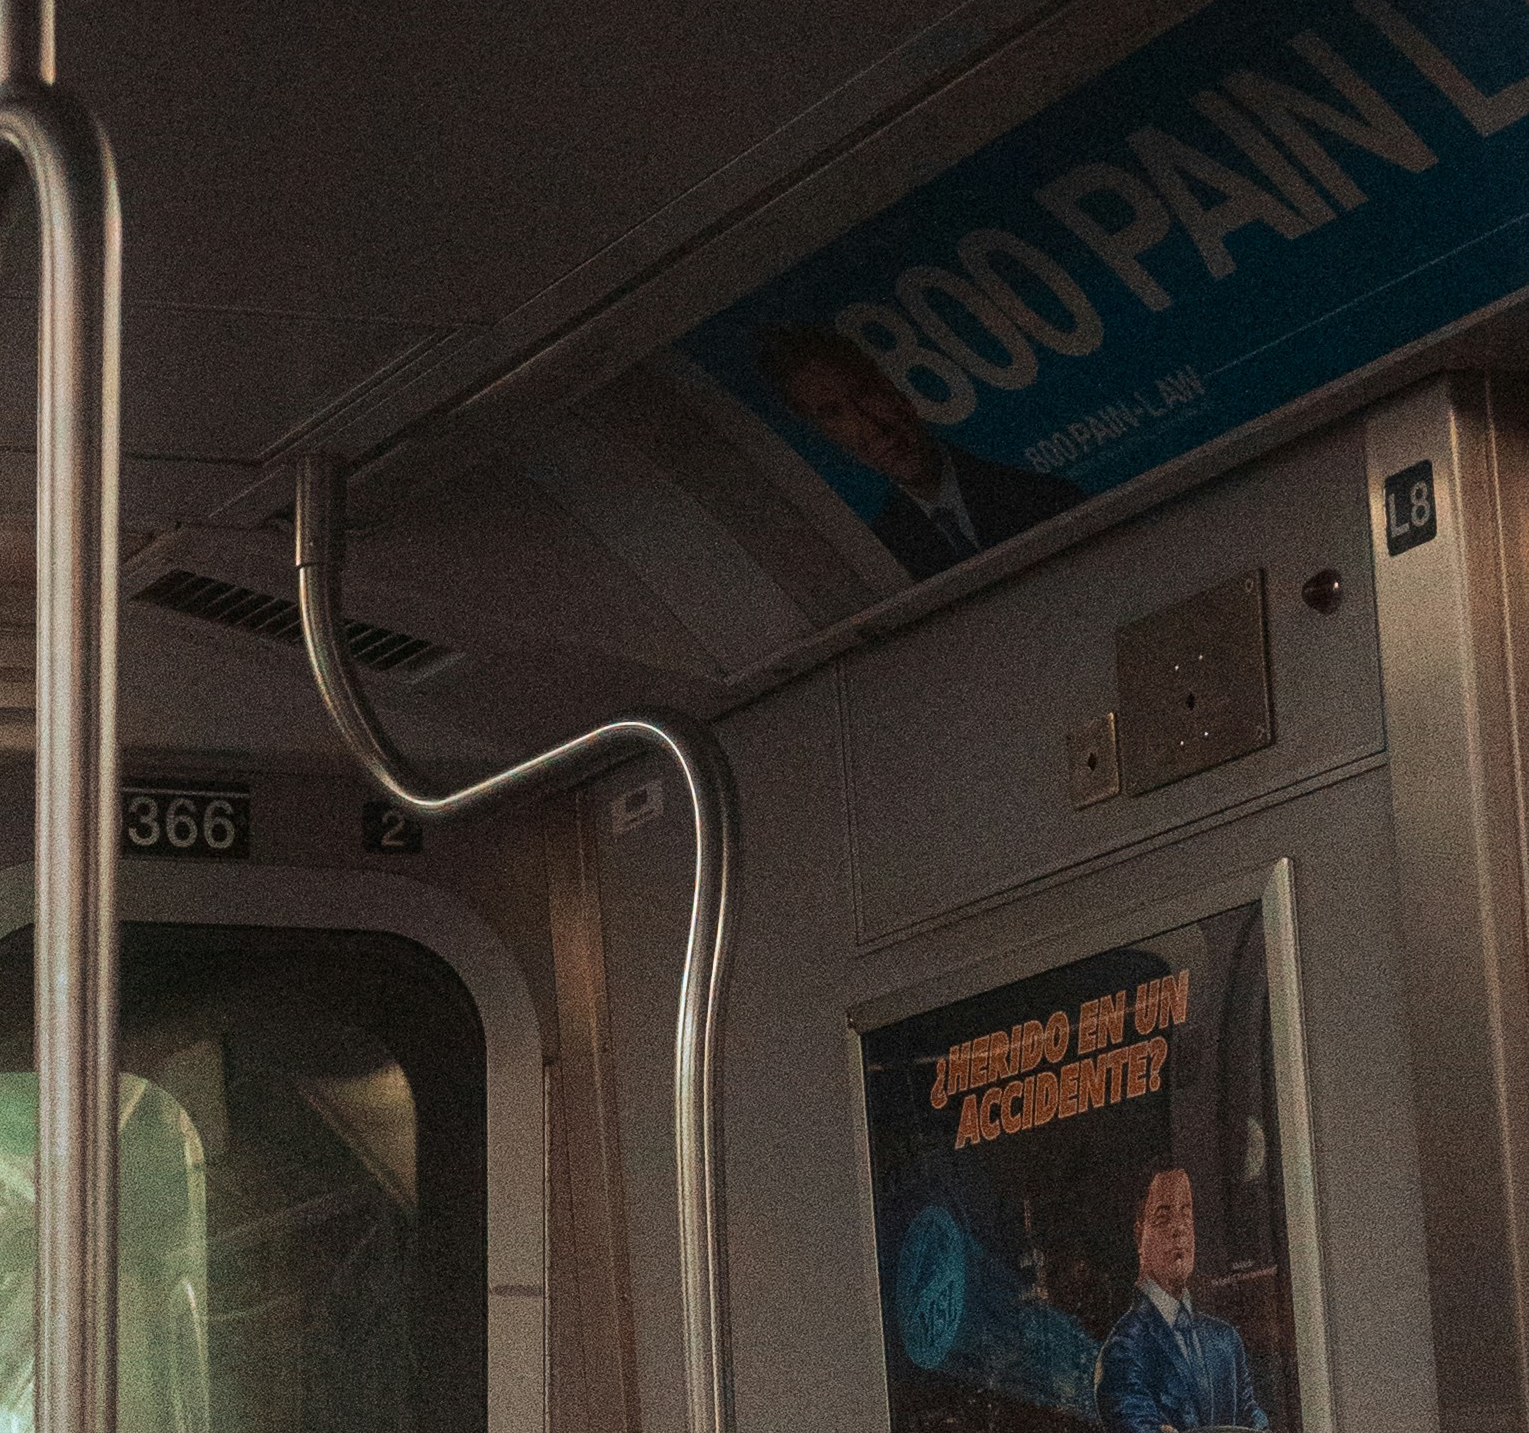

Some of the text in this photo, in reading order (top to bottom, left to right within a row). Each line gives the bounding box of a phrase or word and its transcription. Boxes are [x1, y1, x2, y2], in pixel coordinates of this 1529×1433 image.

[835, 227, 1104, 426] 800
[1033, 28, 1439, 313] PAIN
[1024, 431, 1078, 474] 800
[1387, 480, 1431, 538] L8
[119, 795, 236, 850] 366
[381, 809, 406, 847] 2
[929, 969, 1190, 1110] ¿HERIDO EN UN
[953, 1035, 1168, 1150] ACCIDENTE?
